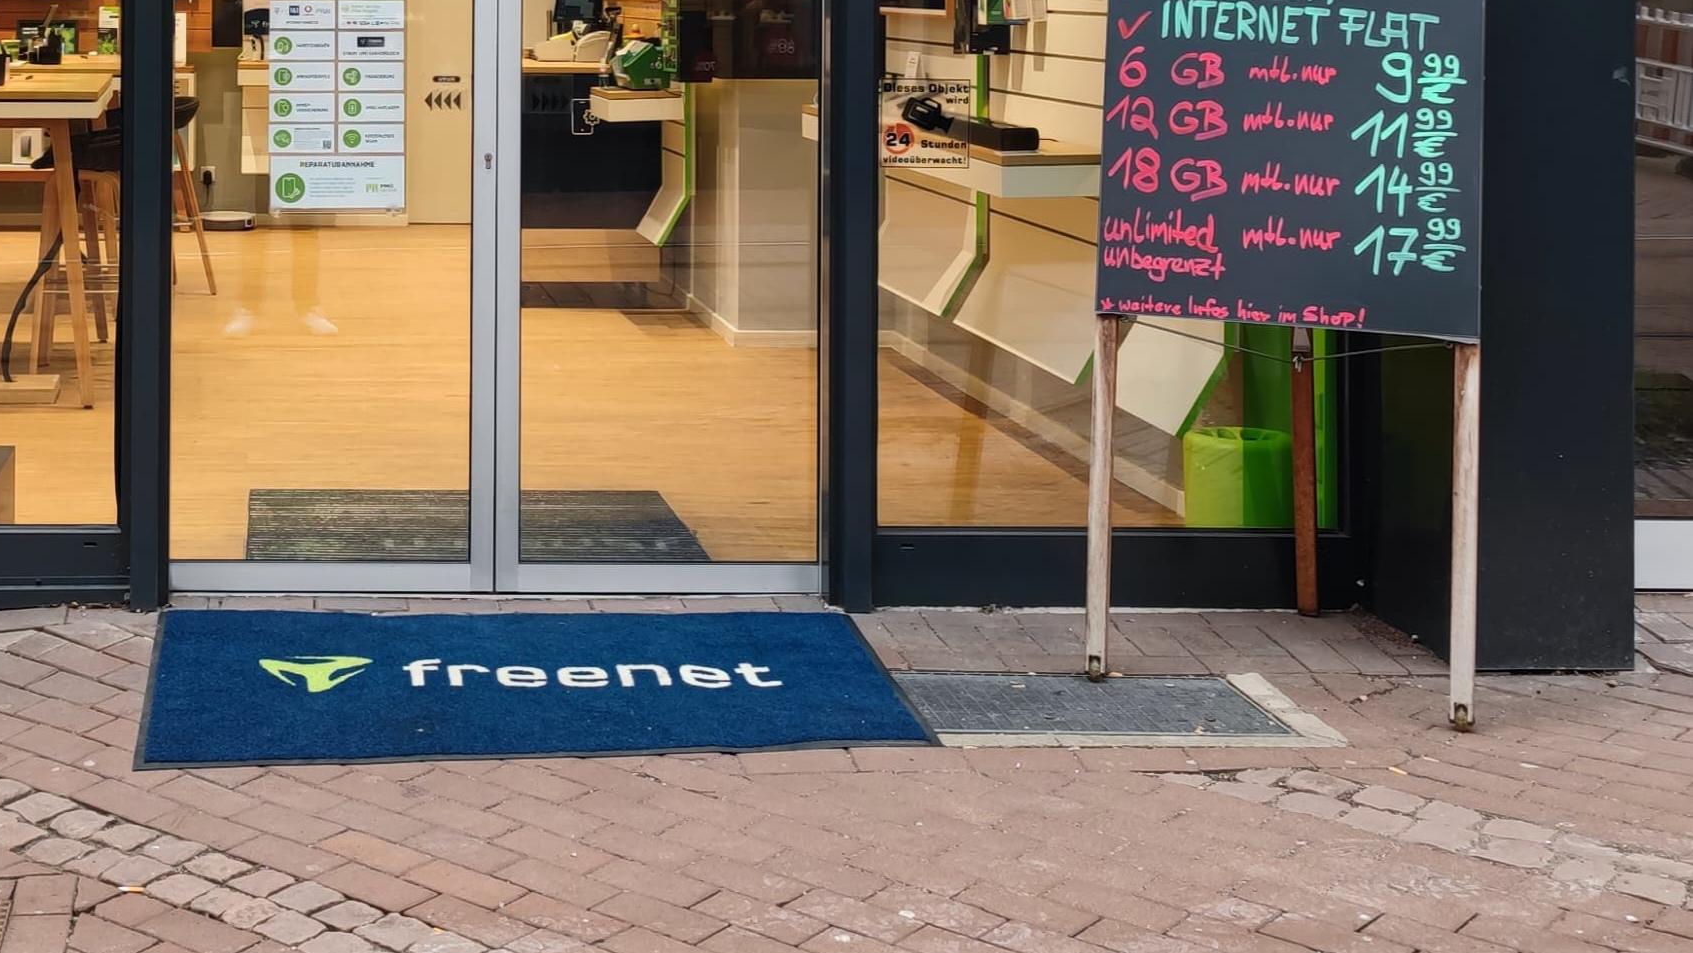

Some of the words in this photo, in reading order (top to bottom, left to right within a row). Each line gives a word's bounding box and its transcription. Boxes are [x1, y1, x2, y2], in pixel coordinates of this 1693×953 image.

[1161, 0, 1330, 43] INTERNET
[1339, 8, 1441, 51] FLAT
[1119, 46, 1147, 88] 6
[1171, 52, 1225, 90] GB
[883, 83, 925, 92] Dieses
[929, 84, 970, 94] Objekt
[946, 96, 969, 104] wird
[1106, 94, 1159, 140] 12
[1169, 101, 1228, 141] GB
[886, 132, 911, 146] 24
[921, 140, 967, 148] Stunden
[883, 155, 967, 164] videoüberwacht!
[1108, 147, 1161, 193] 18
[1170, 158, 1228, 202] GB
[1103, 245, 1226, 282] unbegrenzt
[1302, 306, 1366, 329] Shop!
[403, 657, 783, 690] freenet
